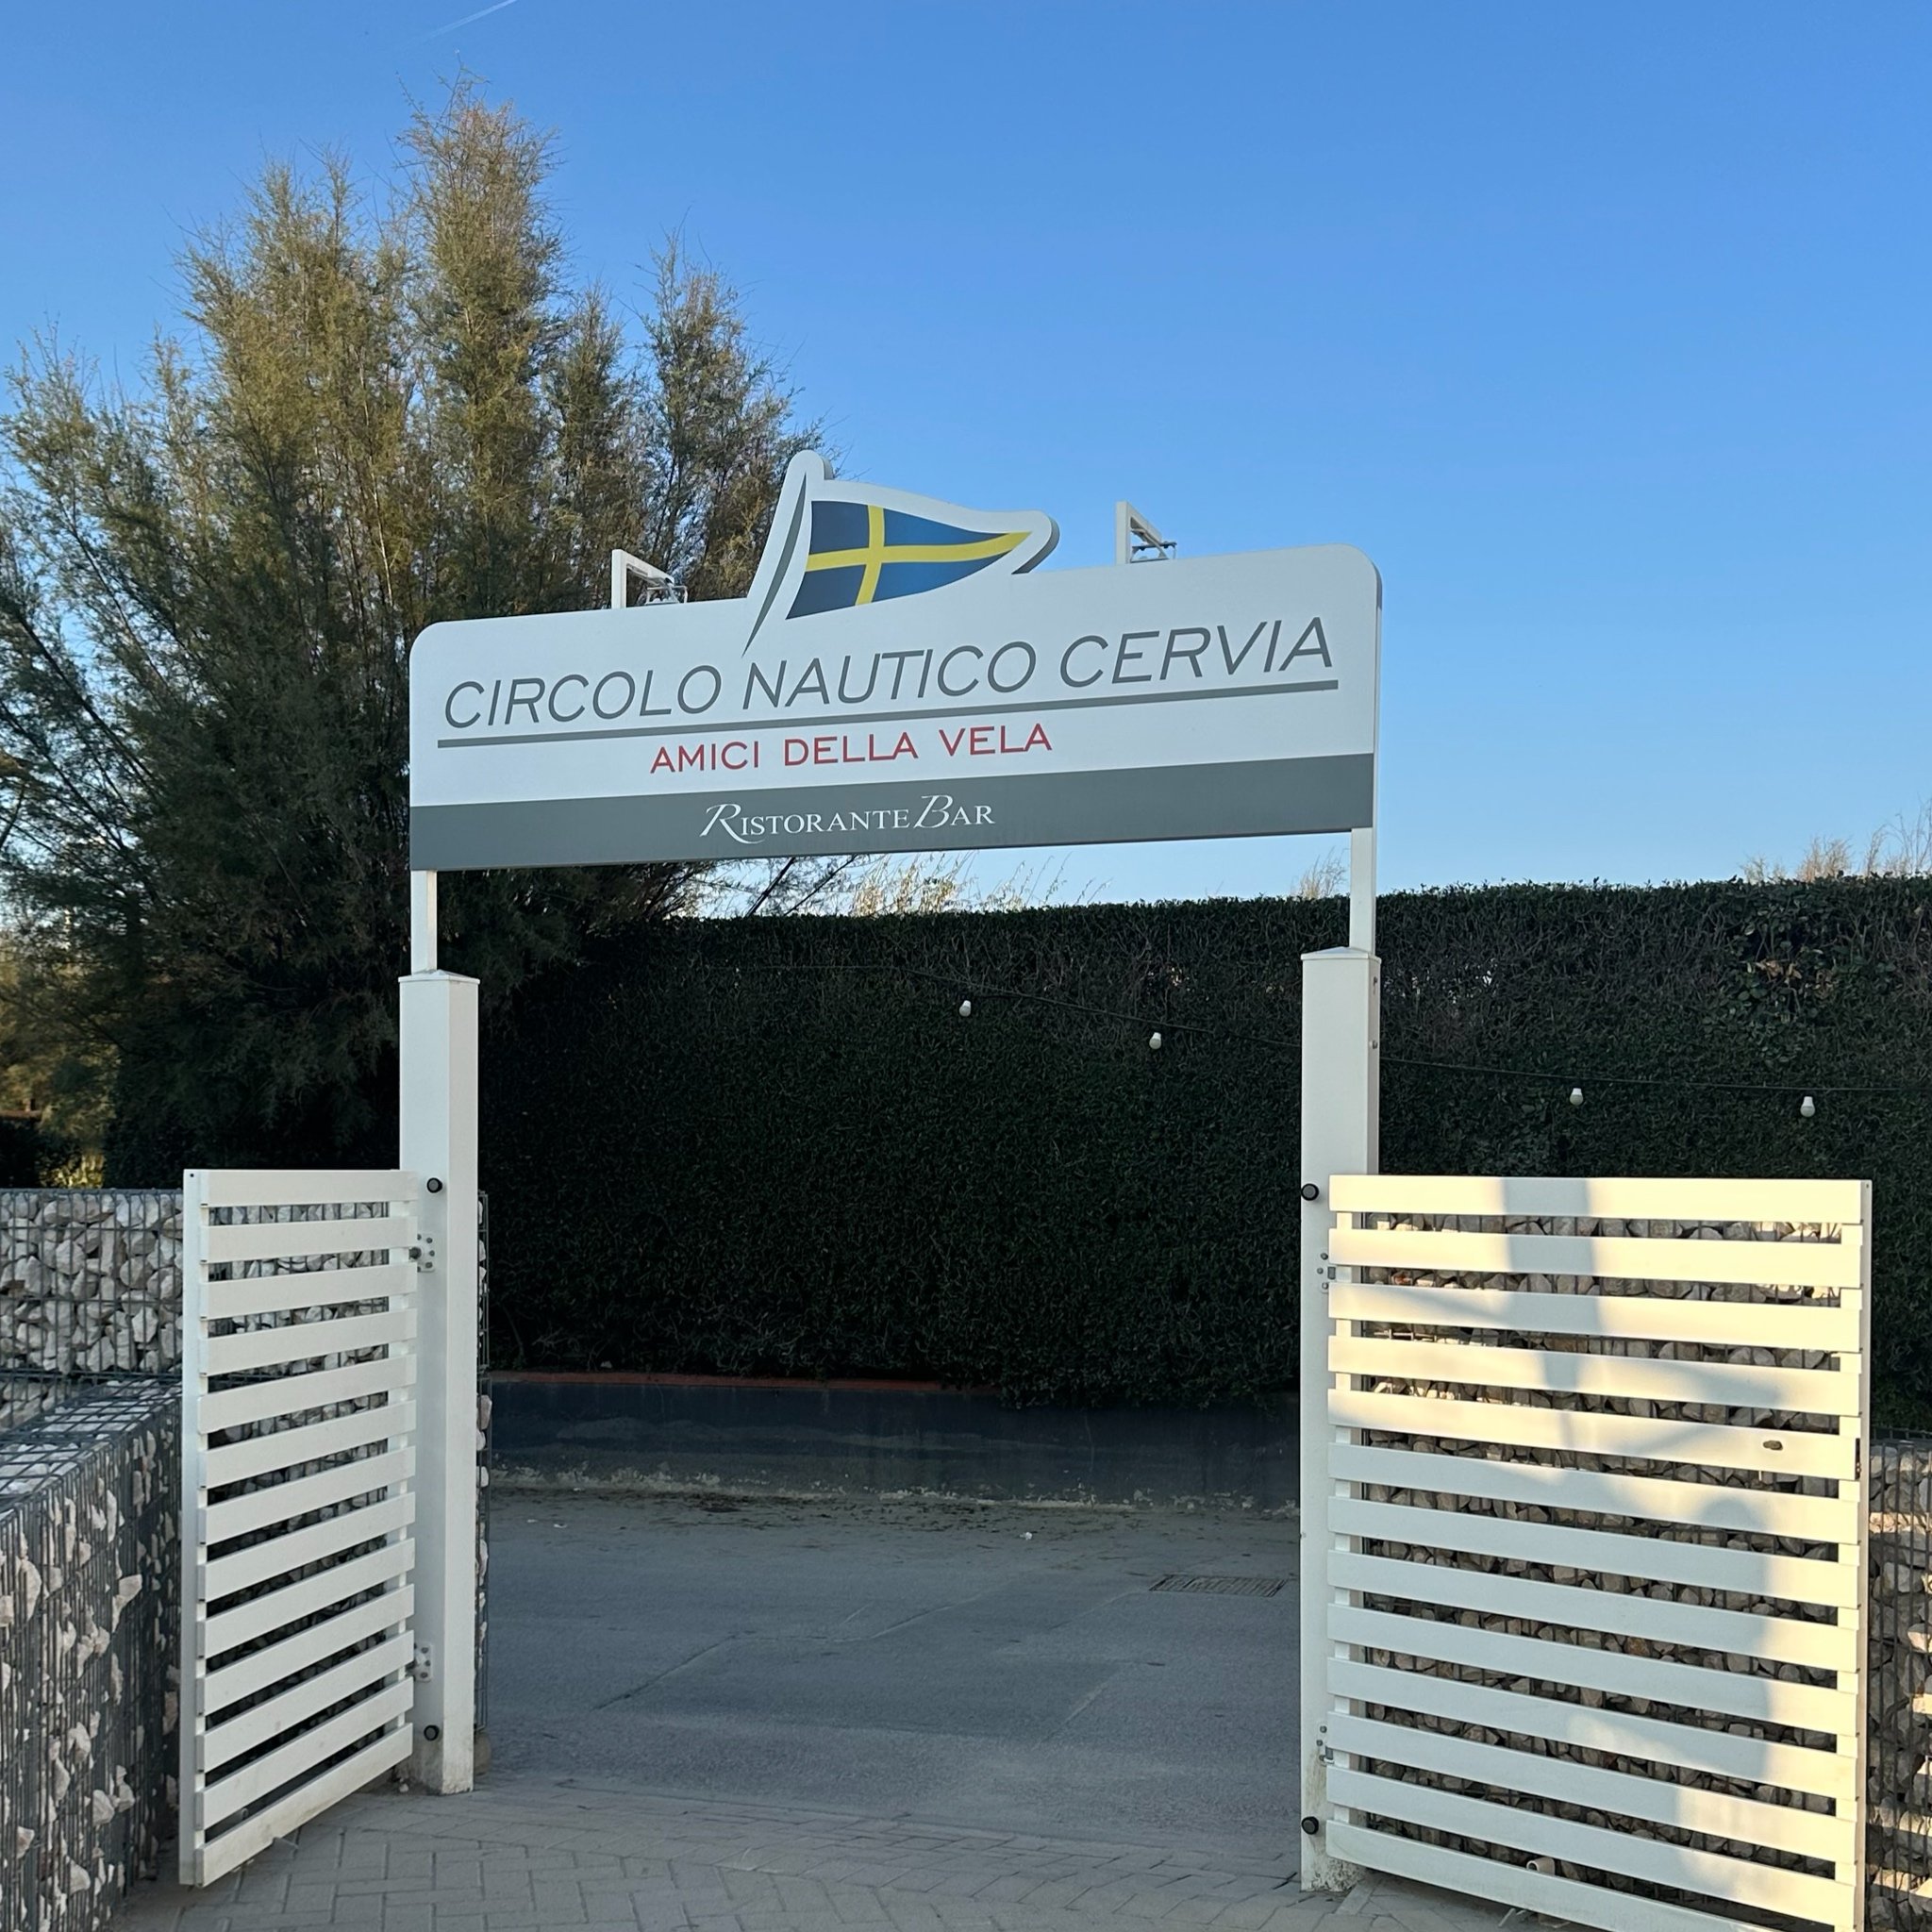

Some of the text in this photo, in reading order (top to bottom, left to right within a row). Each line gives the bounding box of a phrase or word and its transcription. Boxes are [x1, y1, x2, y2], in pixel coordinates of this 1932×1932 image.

[445, 616, 1333, 729] CIRCOLO NAUTICO CERVIA
[650, 723, 1053, 775] AMICI DELLA VELA
